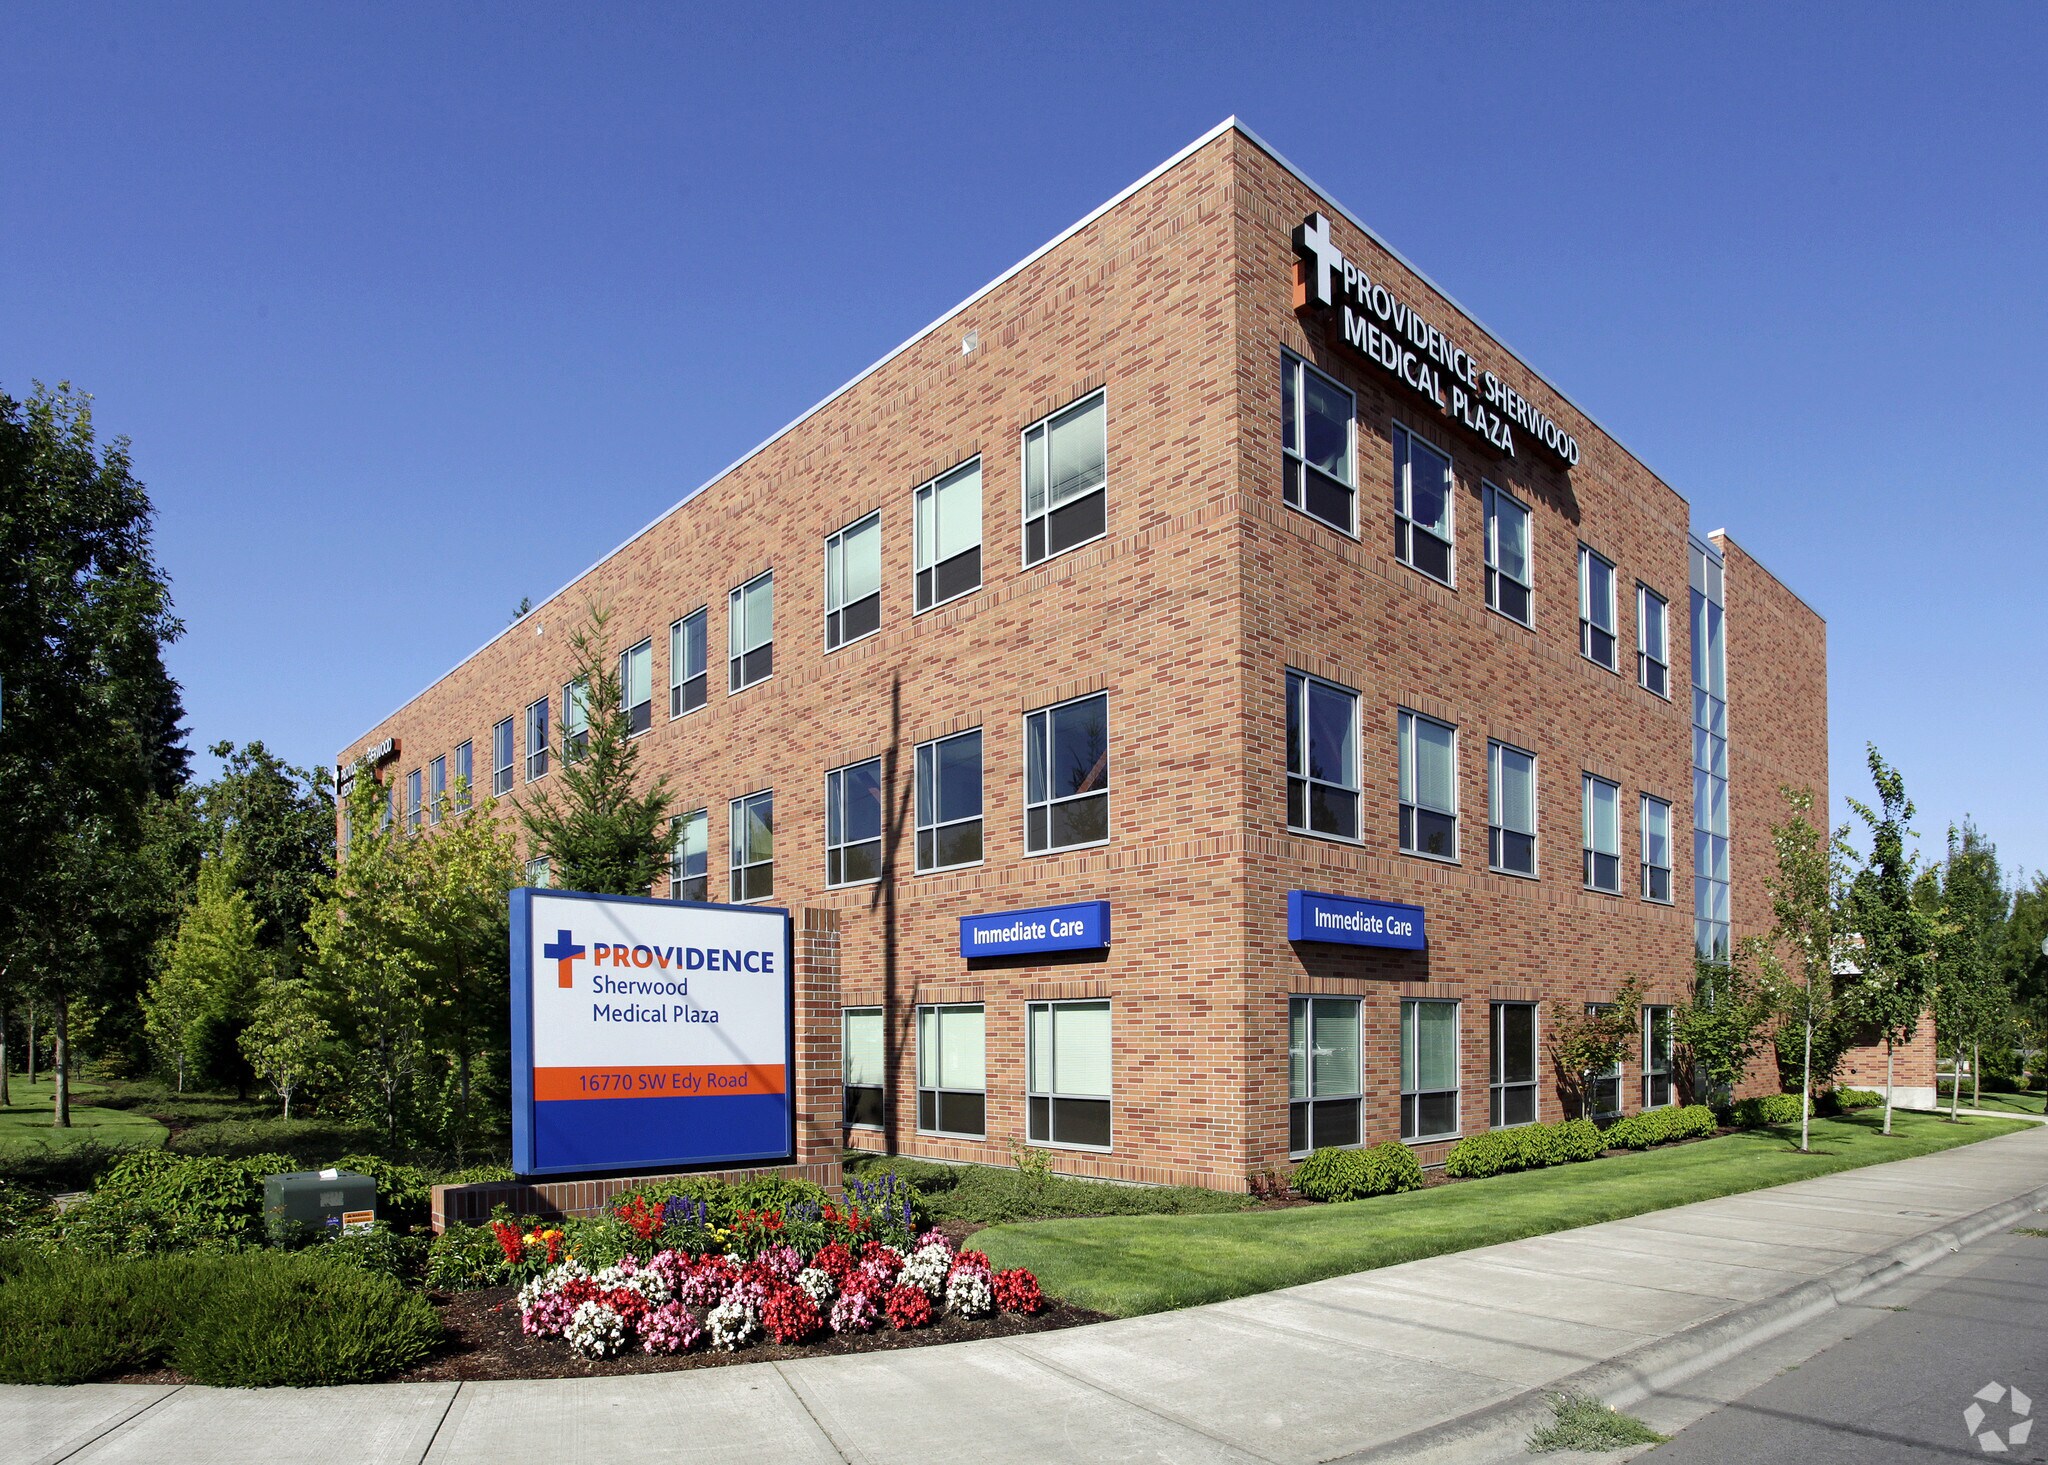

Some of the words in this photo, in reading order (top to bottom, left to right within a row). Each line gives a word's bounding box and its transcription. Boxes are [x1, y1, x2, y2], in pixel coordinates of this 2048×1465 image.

[1343, 257, 1477, 391] PROVIDENCE
[1484, 372, 1580, 466] SHERWOOD
[1344, 305, 1445, 408] MEDICAL
[1452, 385, 1515, 457] PLAZA
[974, 922, 1046, 944] Immediate
[1050, 919, 1084, 938] Care
[1315, 907, 1383, 933] Immediate
[1386, 916, 1412, 936] Care
[594, 942, 774, 973] PROVIDENCE
[593, 975, 688, 996] Sherwood
[593, 1004, 667, 1022] Medical
[673, 1005, 719, 1023] Plaza
[579, 1074, 632, 1091] 16770
[638, 1074, 666, 1090] SW
[673, 1072, 701, 1093] Edy
[708, 1072, 748, 1088] Road
